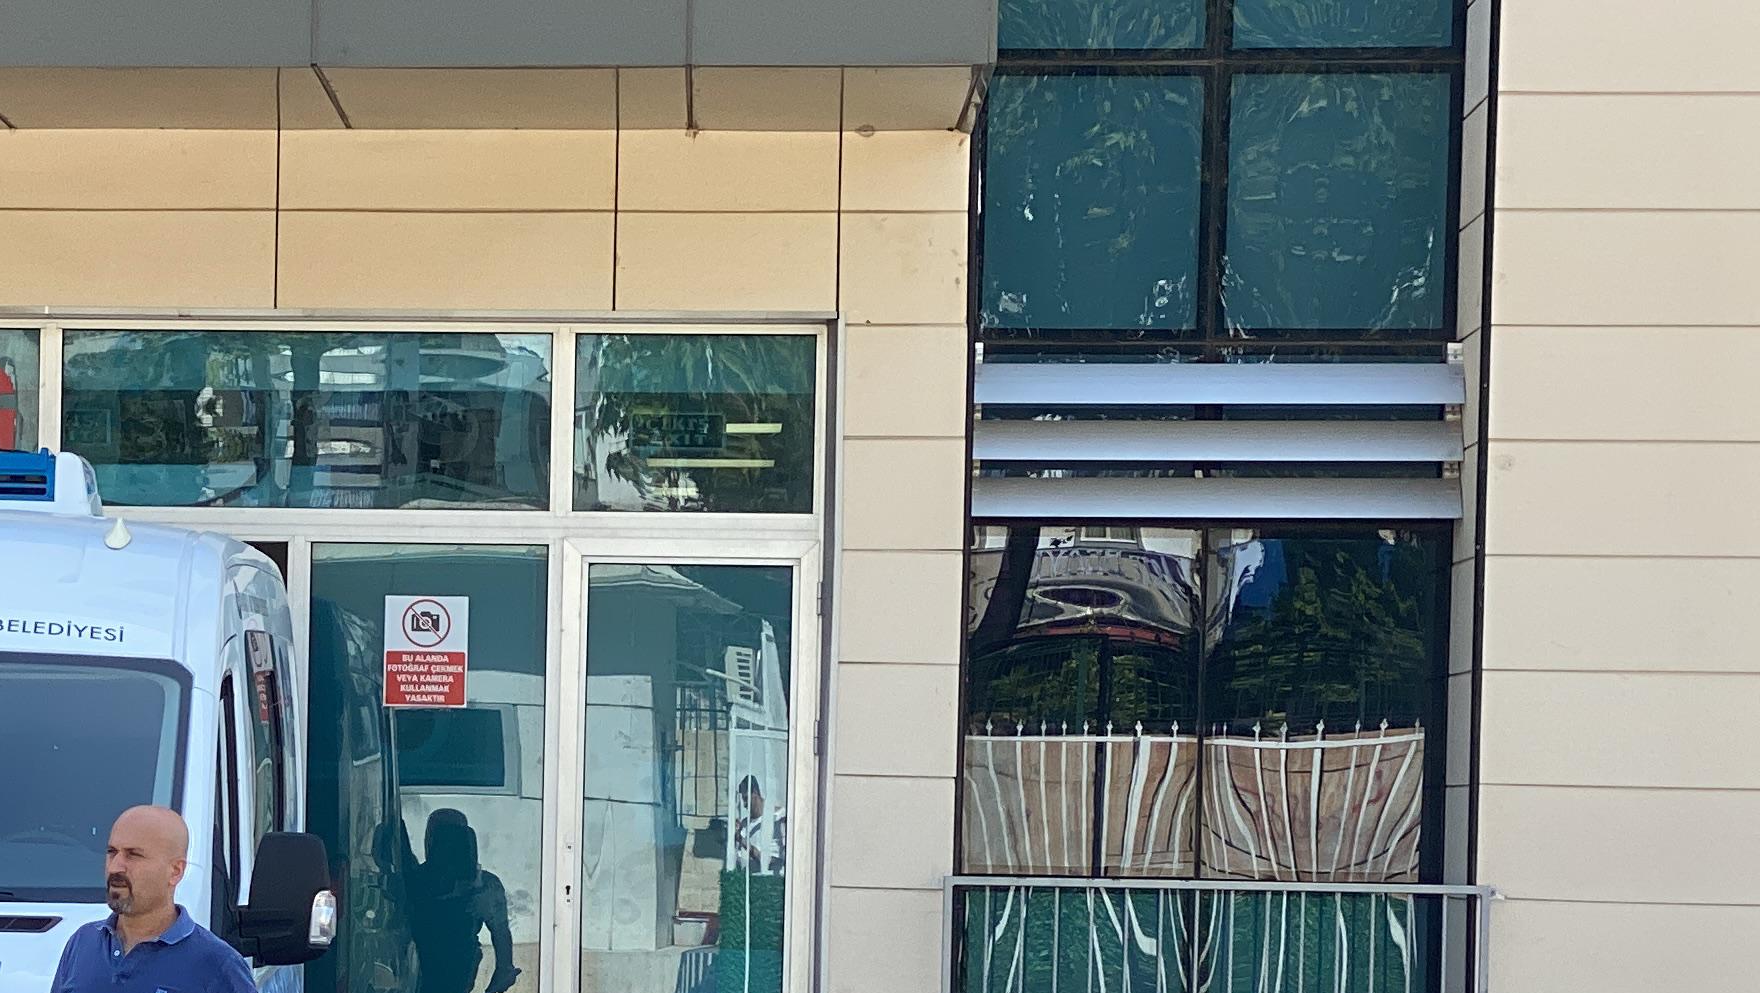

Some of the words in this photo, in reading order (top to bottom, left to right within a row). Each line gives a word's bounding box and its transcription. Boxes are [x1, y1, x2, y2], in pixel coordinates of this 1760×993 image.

[415, 654, 449, 663] ALANDA
[387, 663, 429, 672] FOTOĞRAF
[397, 674, 418, 682] VEYA
[420, 674, 454, 683] KAMERA
[400, 684, 450, 693] KULLANMAK
